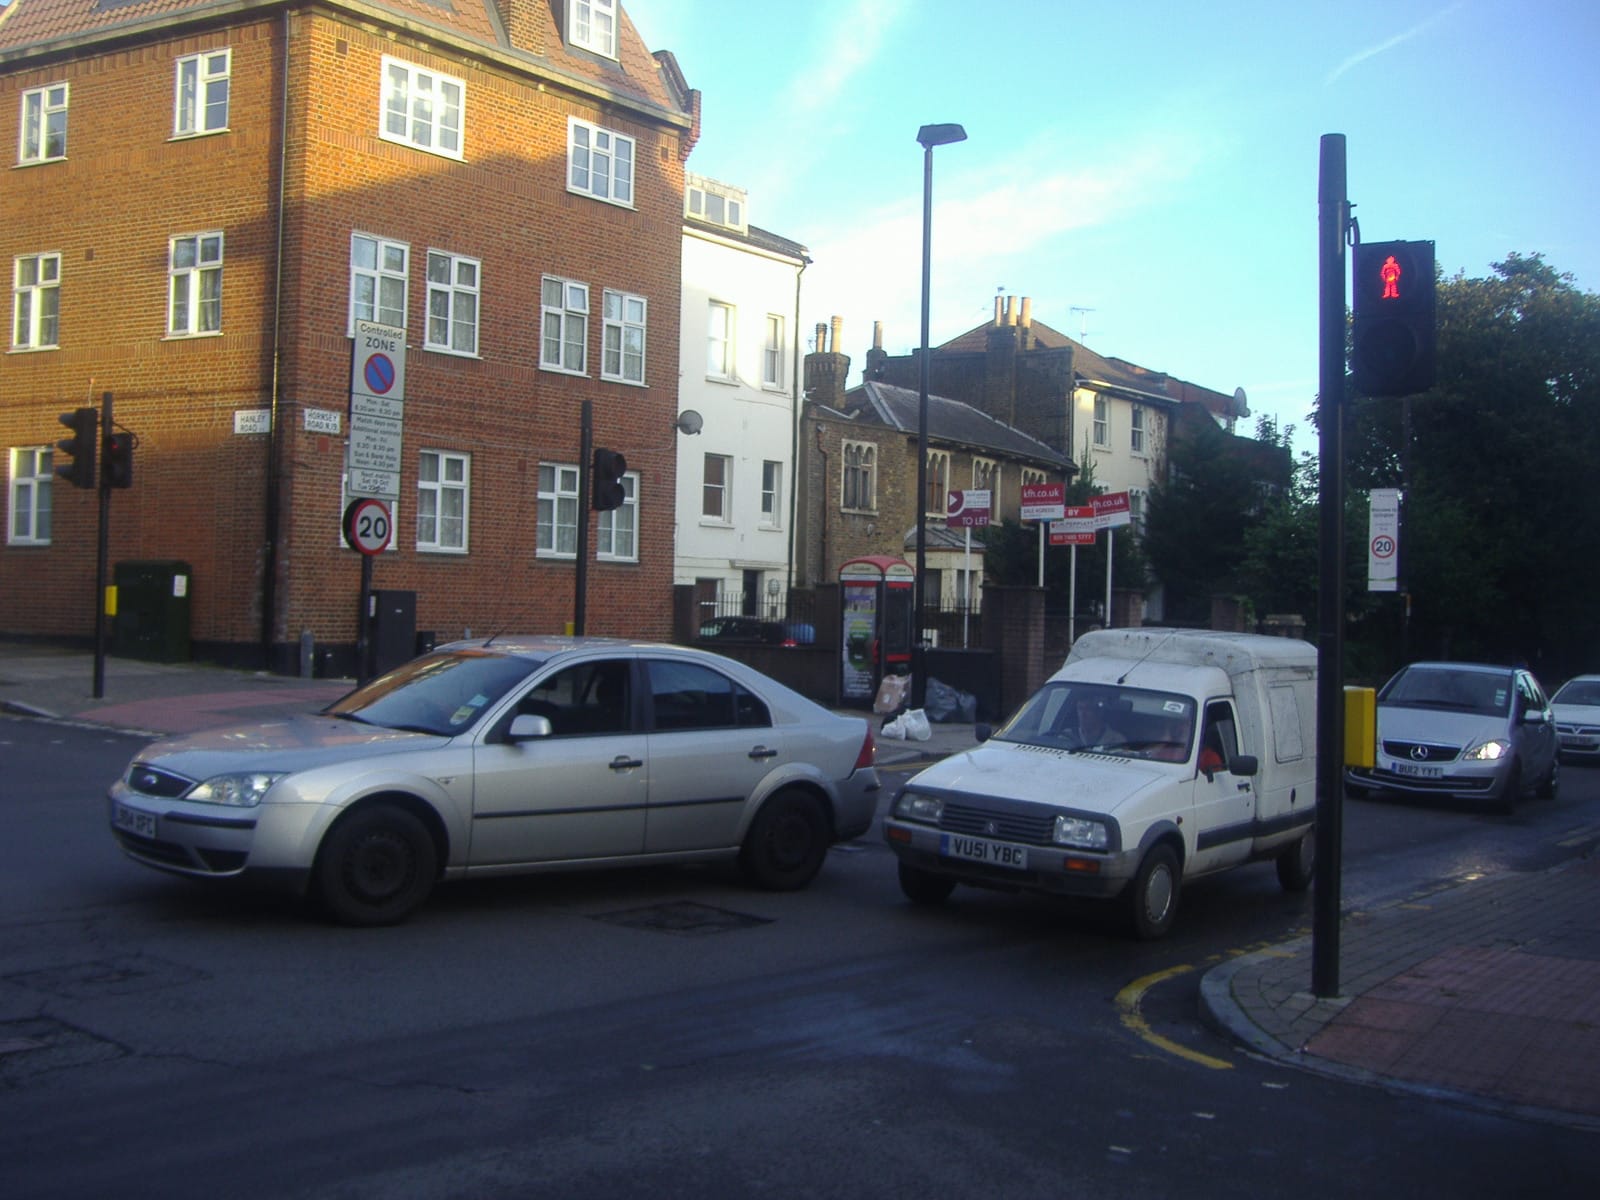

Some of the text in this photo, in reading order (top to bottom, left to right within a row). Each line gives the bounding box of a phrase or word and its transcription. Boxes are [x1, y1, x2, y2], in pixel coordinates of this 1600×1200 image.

[360, 323, 403, 339] Controlled
[365, 337, 396, 352] ZONE
[240, 415, 265, 425] HANLEY
[308, 411, 337, 422] HORNSEY
[240, 424, 258, 433] ROAD
[307, 420, 323, 430] ROAD
[1023, 487, 1060, 498] kfh.co.uk
[1068, 508, 1079, 517] BY
[962, 516, 988, 526] TO LET
[359, 515, 387, 539] 20
[1375, 541, 1392, 553] 20
[1421, 766, 1440, 777] YYT
[953, 838, 1022, 865] VU51 YBC
